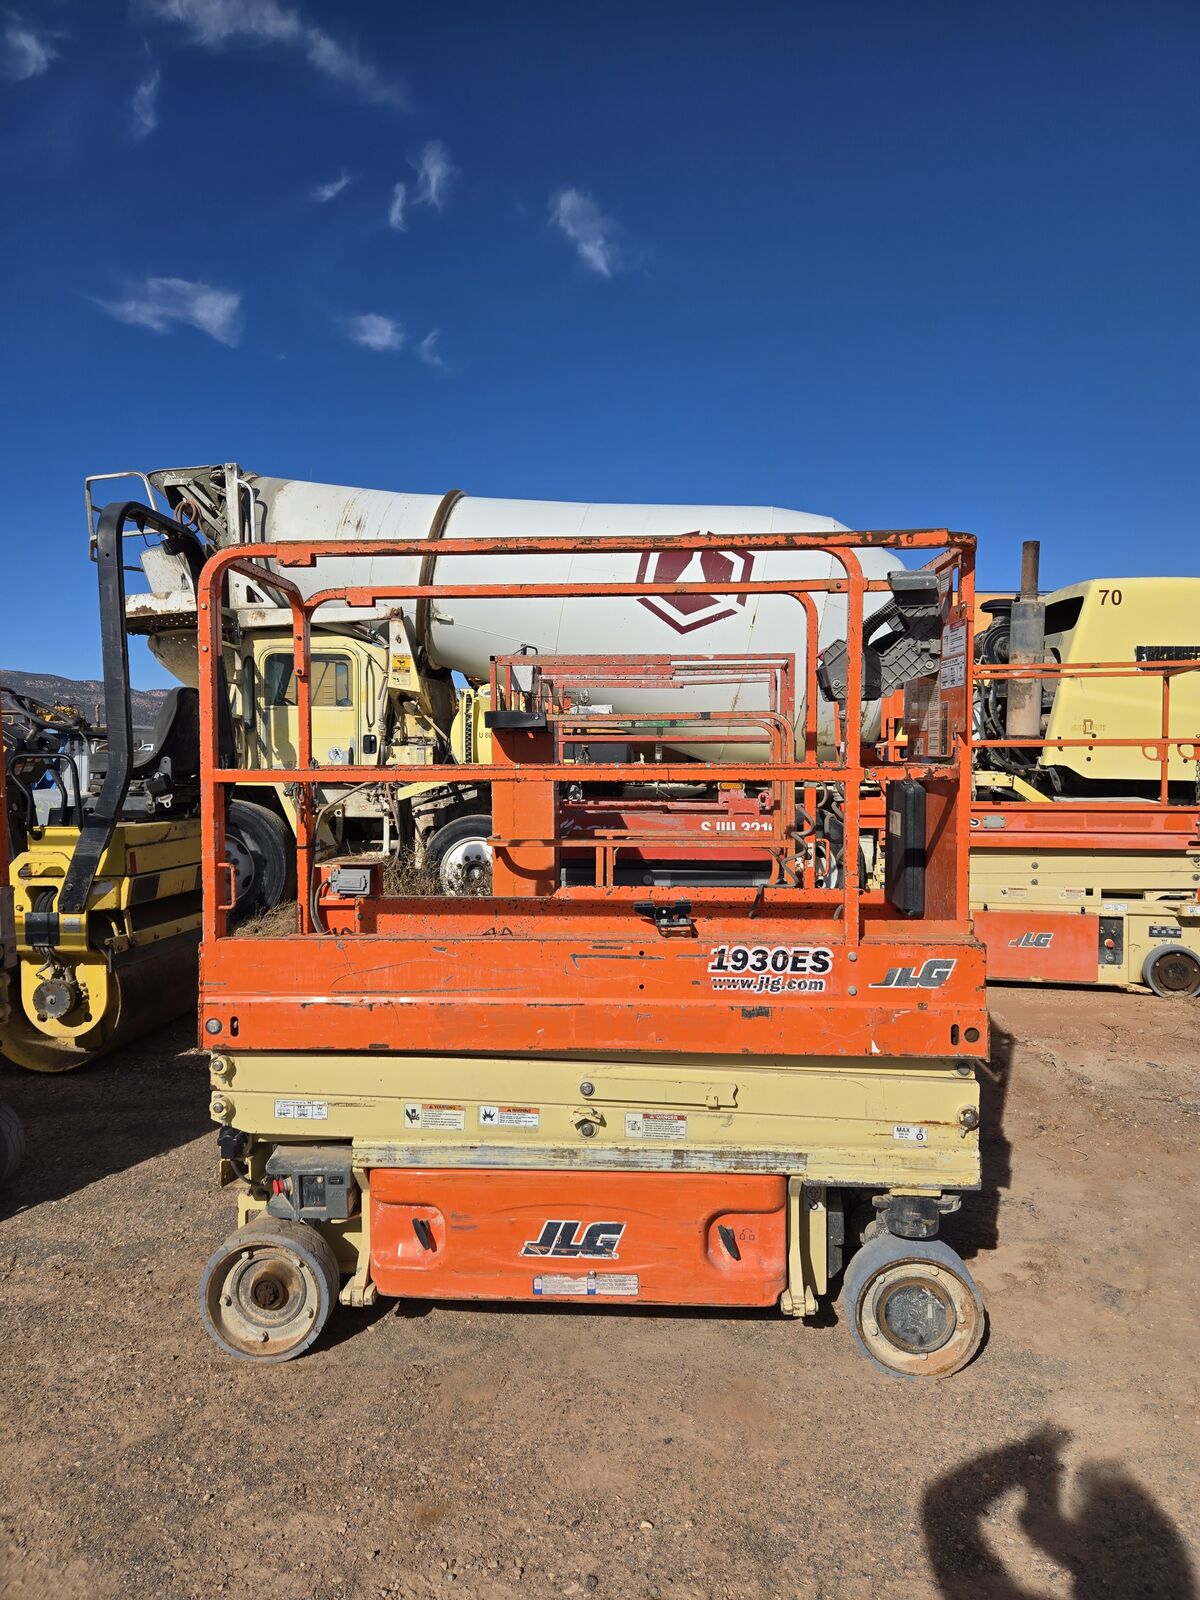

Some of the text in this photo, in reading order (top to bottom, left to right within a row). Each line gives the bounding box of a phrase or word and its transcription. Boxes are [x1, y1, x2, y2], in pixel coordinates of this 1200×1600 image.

[1098, 589, 1123, 606] 70
[709, 946, 833, 974] 1930ES
[868, 958, 957, 989] JLG
[712, 976, 825, 994] www.jlg.com
[518, 1219, 627, 1260] JLG
